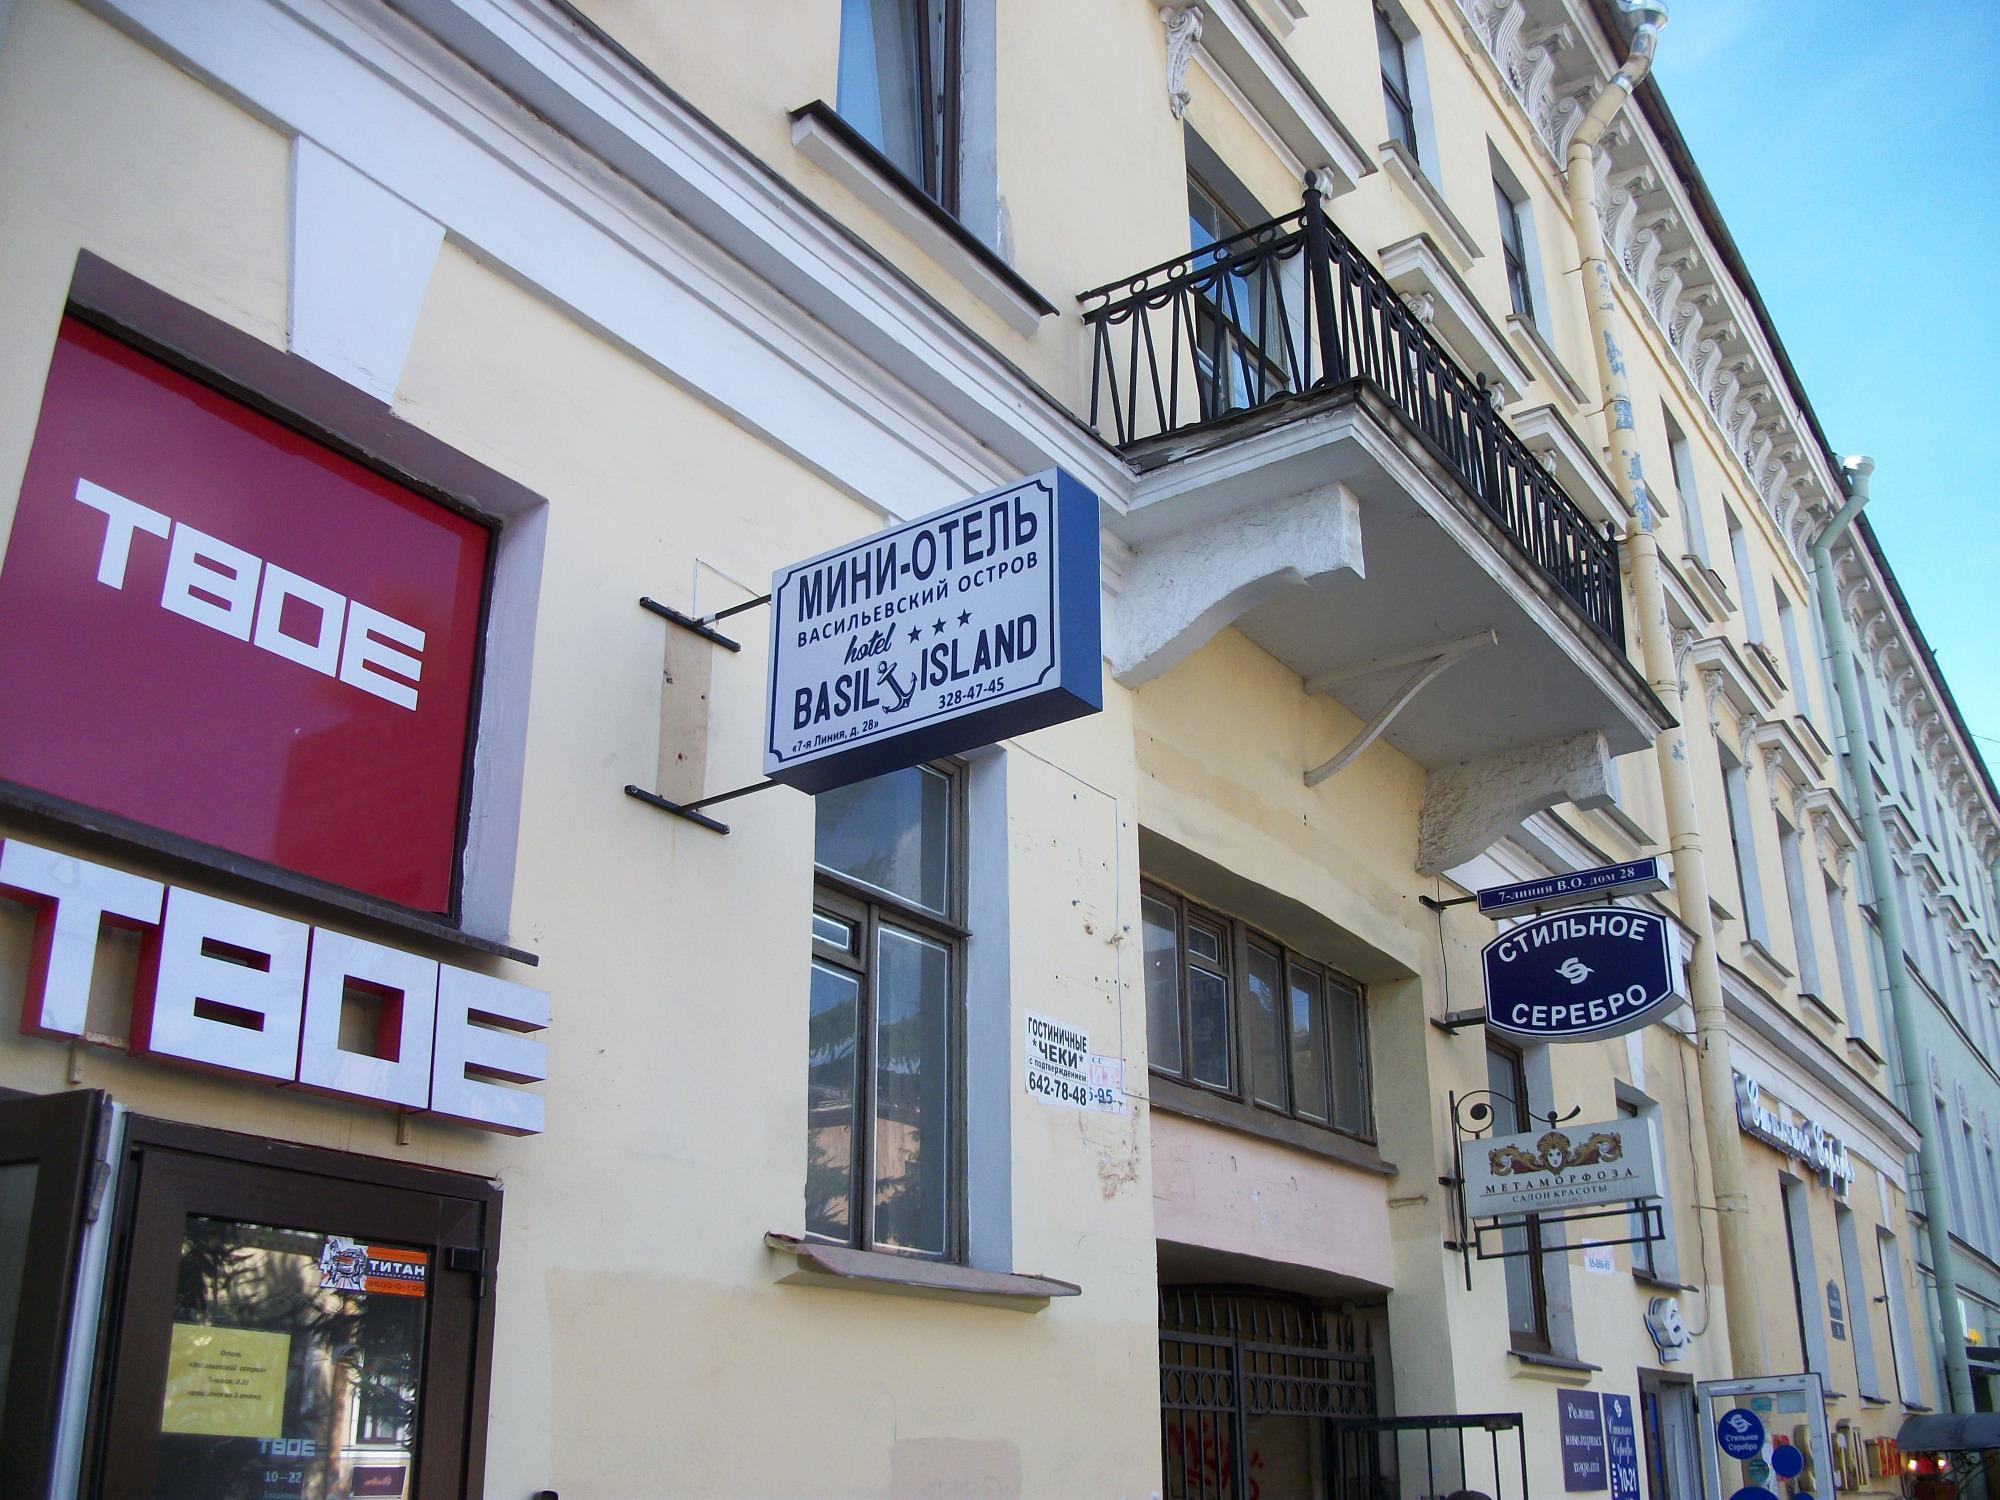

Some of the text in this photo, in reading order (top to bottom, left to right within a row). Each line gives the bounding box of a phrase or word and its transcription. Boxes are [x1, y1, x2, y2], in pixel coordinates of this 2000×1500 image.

[798, 496, 1037, 622] МИНИ-ОТЕЛЬ
[75, 477, 426, 711] ТВОЕ
[797, 552, 1037, 647] ВАСИЛЬЕВСКИЙ ОСТРОВ
[844, 623, 896, 665] hotel
[794, 614, 1037, 730] BASIL ISLAND
[938, 677, 1005, 710] 328-47-45
[814, 728, 848, 747] Линия,
[863, 719, 879, 731] 28»
[1499, 867, 1635, 902] 7-линия В.О. дом 28
[1498, 915, 1648, 962] СТИЛЬНОЕ
[0, 837, 550, 1136] ТВОЕ
[1512, 984, 1647, 1026] СЕРЕБРО
[1028, 1017, 1087, 1053] ГОСТИНИЧНЫЕ
[1034, 1060, 1087, 1082] подтверждением
[1029, 1072, 1087, 1106] 642-78-48
[1485, 1168, 1634, 1194] МЕТАМОРФОЗА
[1512, 1190, 1550, 1203] САЛОН
[1554, 1184, 1608, 1197] КРАСОТЫ
[370, 1260, 425, 1276] ТИТАН
[258, 1438, 316, 1456] ТВОЕ
[1725, 1434, 1758, 1442] Стильное
[1728, 1443, 1758, 1453] Серебро
